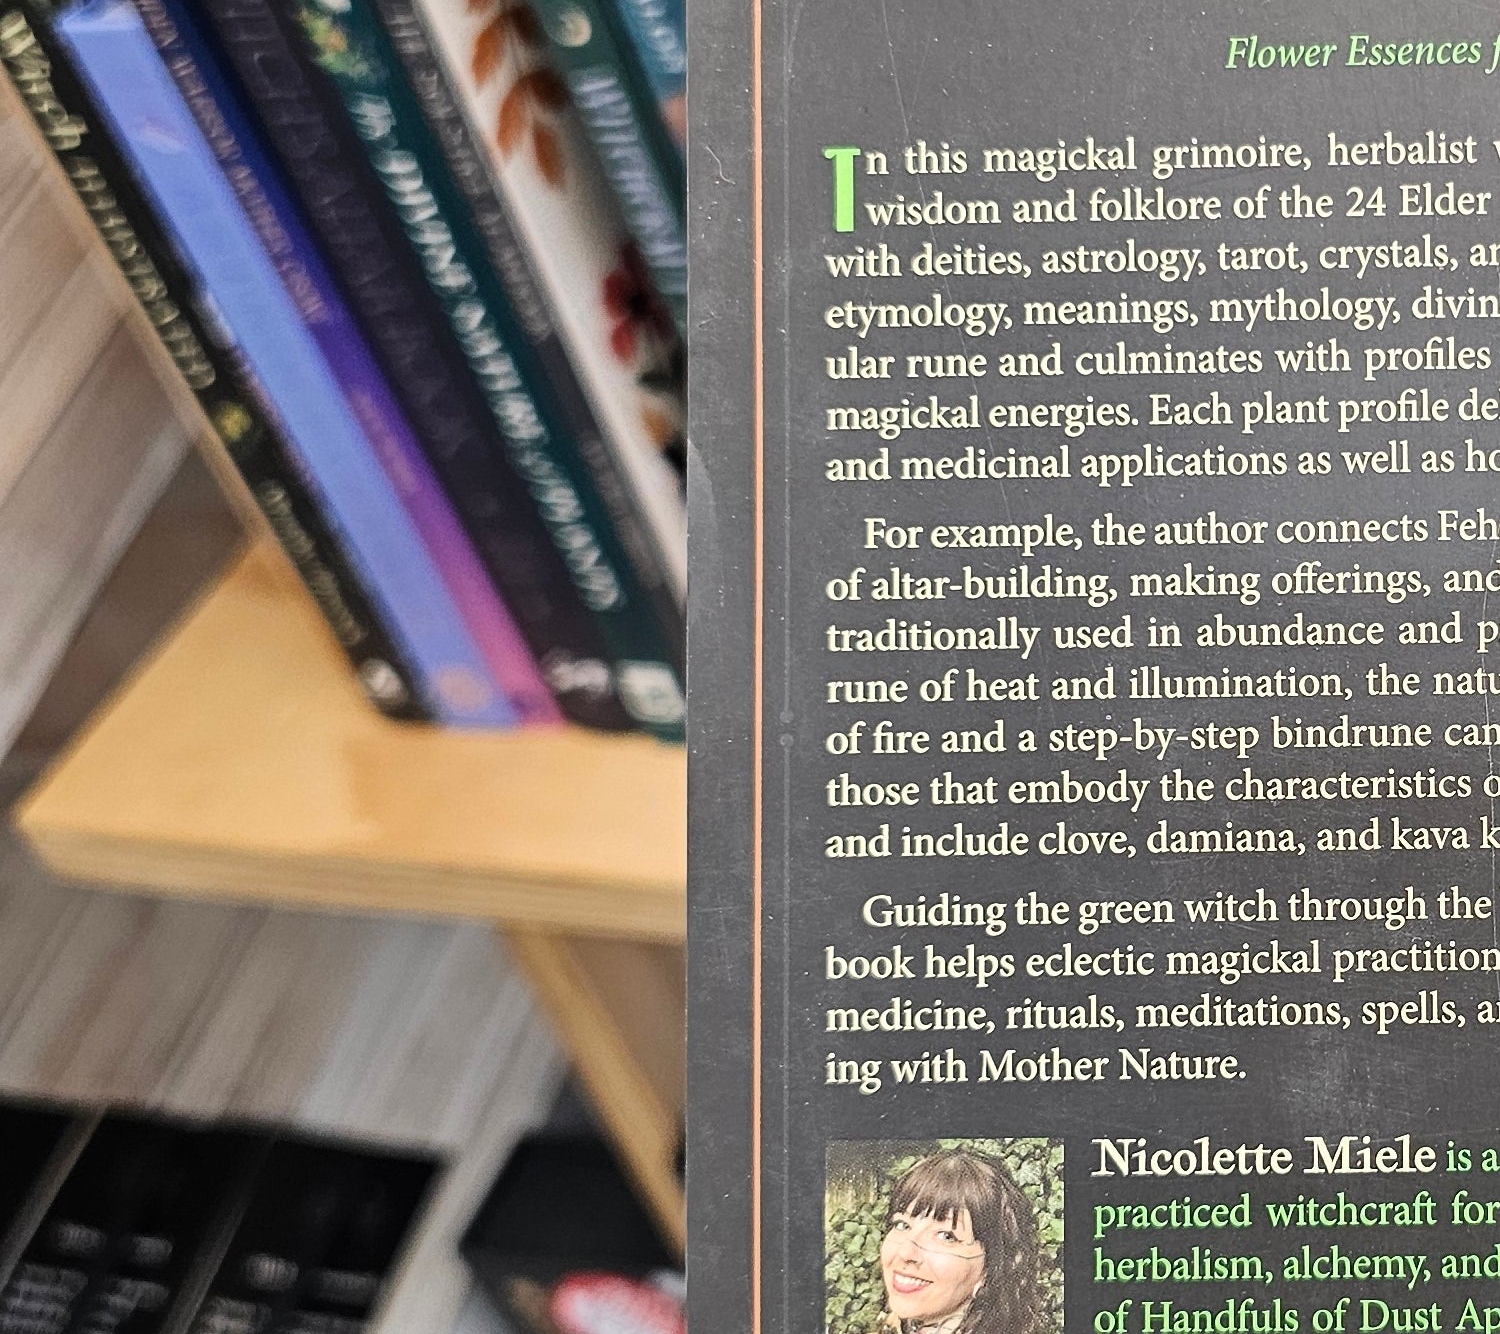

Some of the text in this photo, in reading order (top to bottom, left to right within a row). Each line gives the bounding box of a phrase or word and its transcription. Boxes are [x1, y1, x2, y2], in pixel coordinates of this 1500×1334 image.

[1225, 35, 1337, 68] Flower
[1345, 35, 1481, 65] Essences
[905, 139, 967, 174] this
[983, 136, 1137, 182] magickal
[1153, 135, 1311, 179] grimoire,
[1328, 131, 1477, 165] herbalist
[825, 824, 892, 857] and
[901, 822, 1029, 856] include
[1039, 822, 1136, 858] clove,
[1147, 820, 1305, 855] damiana,
[1317, 817, 1381, 851] and
[1391, 817, 1470, 849] kava
[825, 1047, 1246, 1095] ing with Mother Nature.
[1091, 1137, 1293, 1177] Nicolette
[1303, 1134, 1437, 1174] Miele
[1446, 1141, 1472, 1171] is
[1482, 1149, 1500, 1171] a
